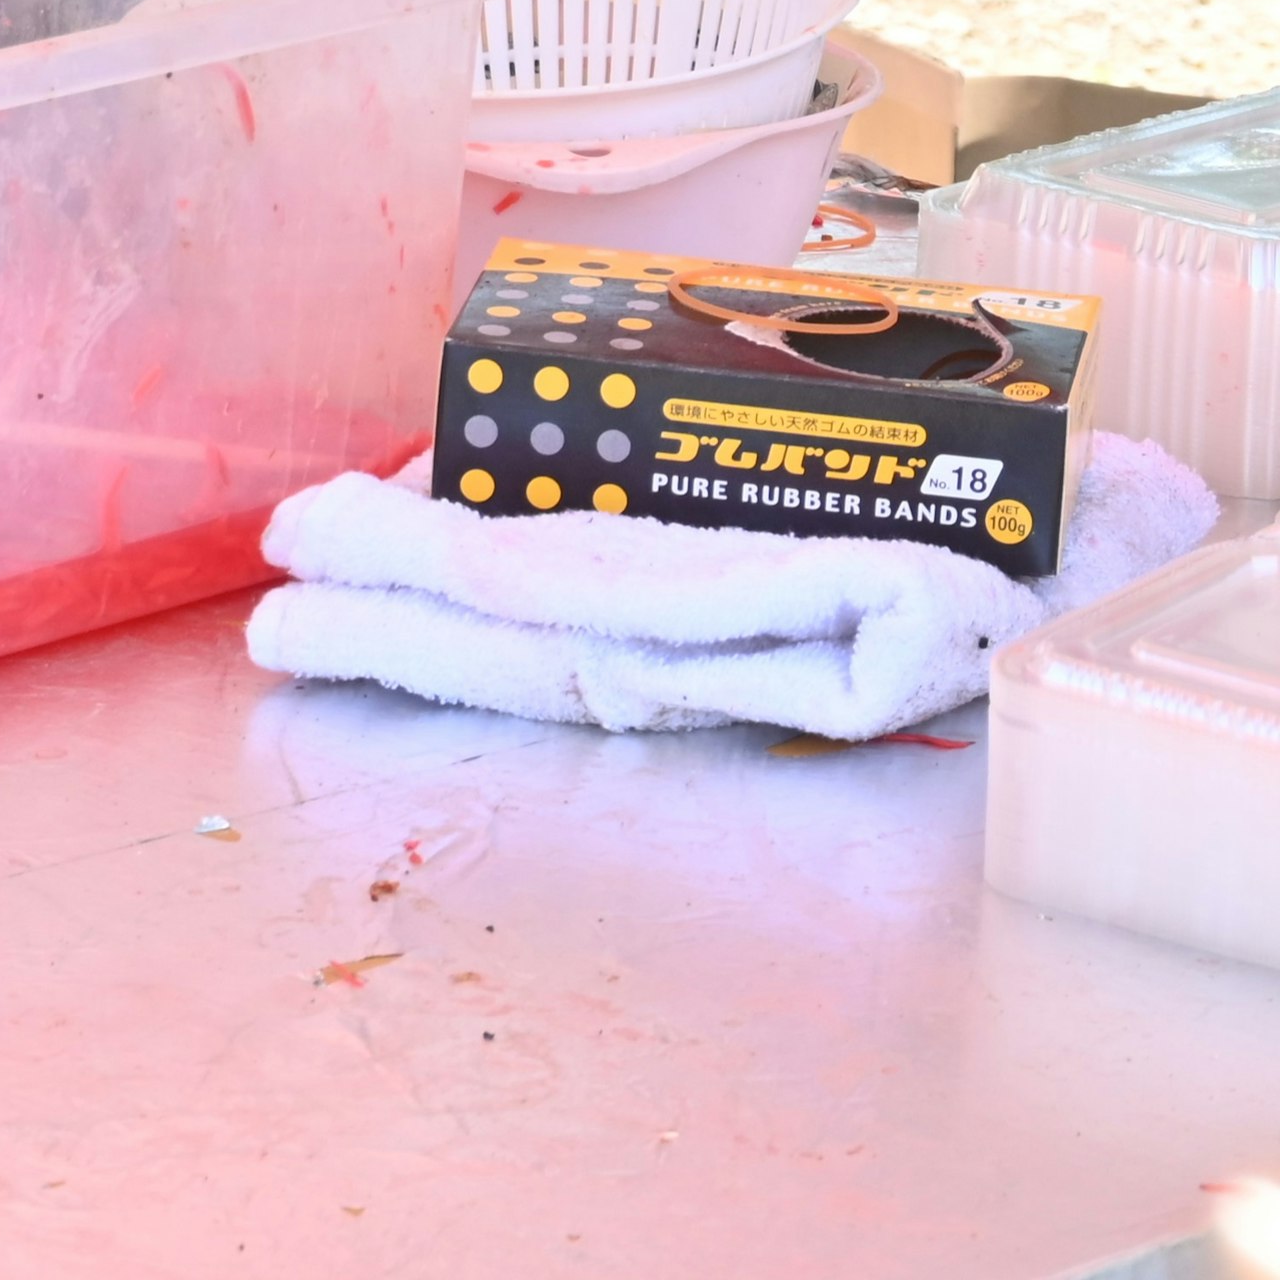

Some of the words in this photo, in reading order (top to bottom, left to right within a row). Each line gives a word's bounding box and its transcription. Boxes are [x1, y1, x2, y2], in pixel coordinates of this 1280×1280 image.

[669, 403, 919, 443] 環境にやさしい天然ゴムの結束材
[654, 431, 927, 485] ゴムバンド
[651, 472, 728, 500] PURE
[741, 482, 862, 516] RUBBER
[874, 497, 977, 528] BANDS
[997, 504, 1020, 516] NET
[989, 516, 1026, 537] 100g
